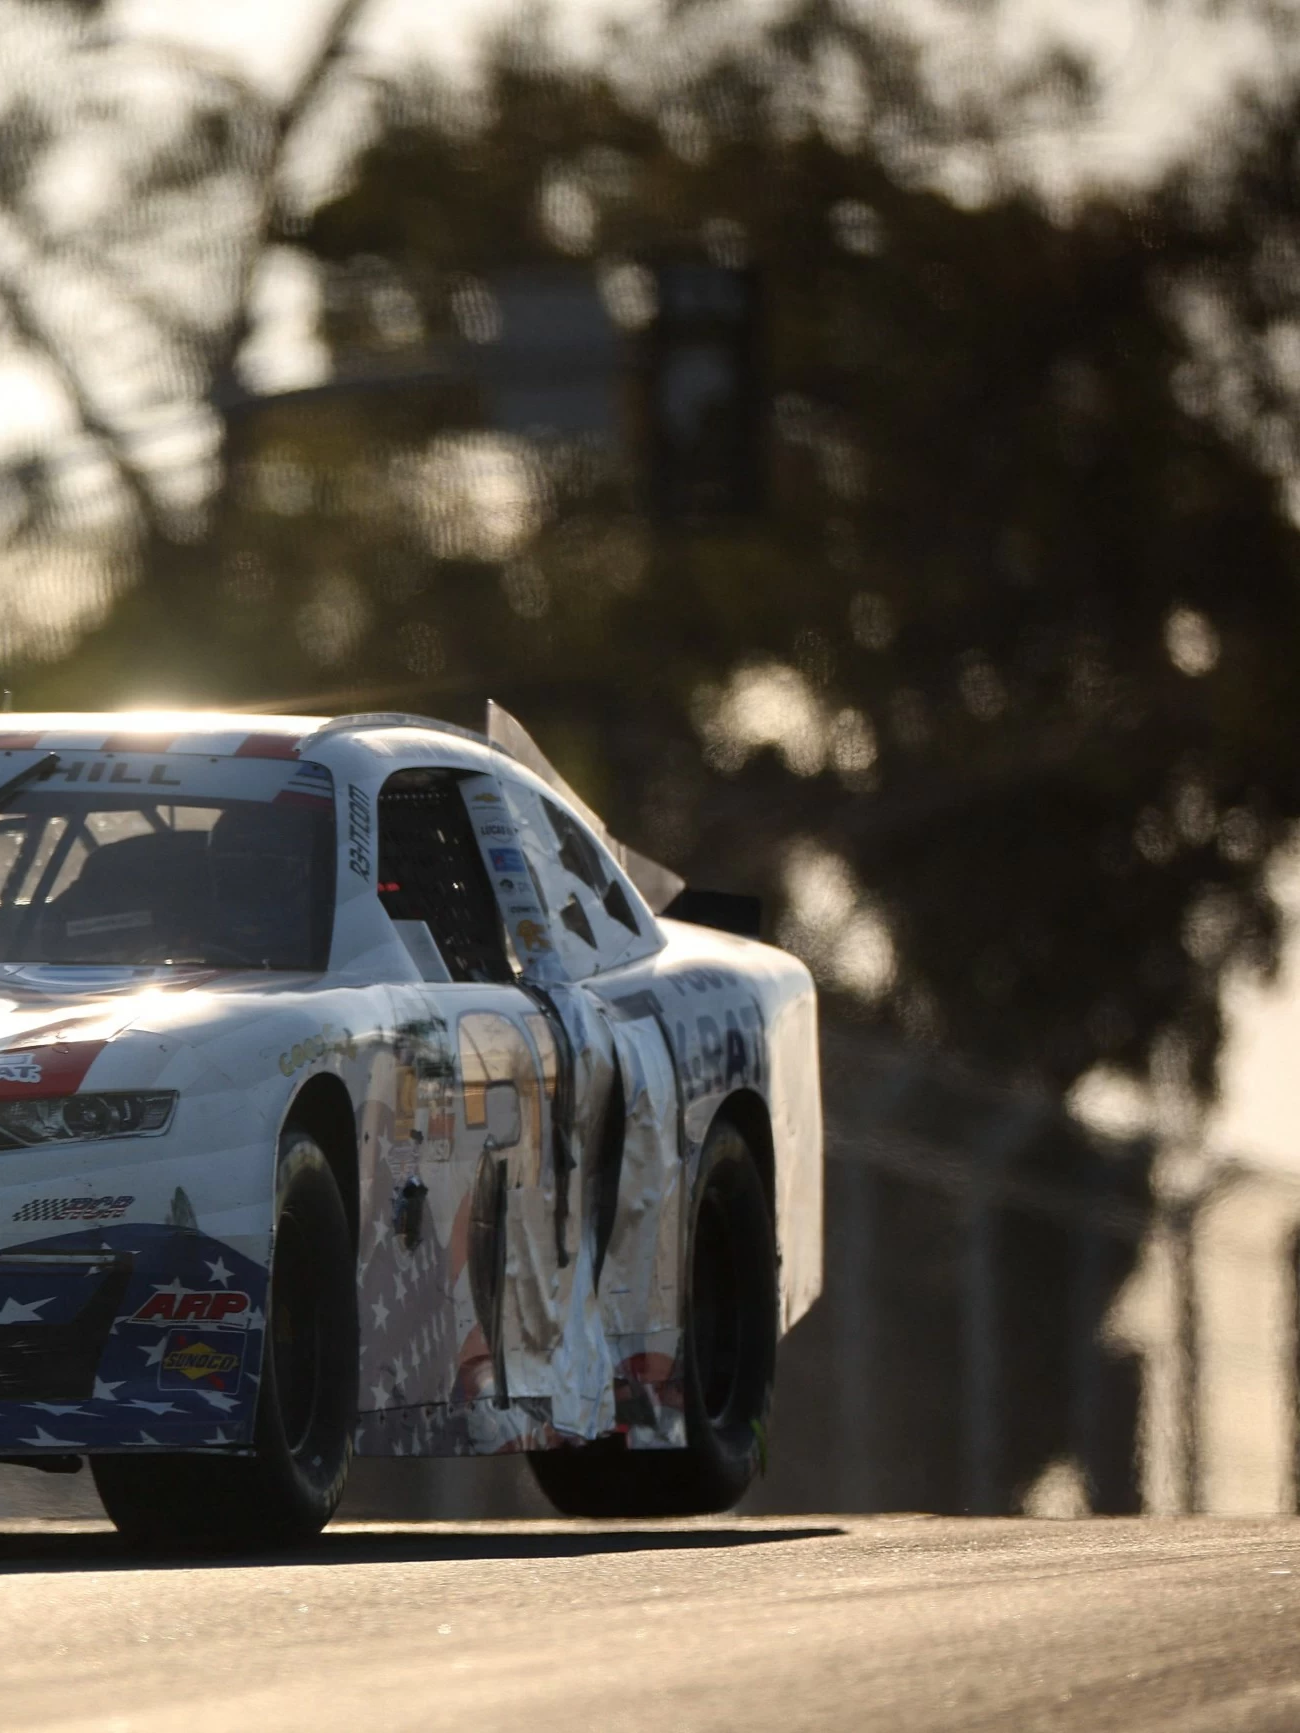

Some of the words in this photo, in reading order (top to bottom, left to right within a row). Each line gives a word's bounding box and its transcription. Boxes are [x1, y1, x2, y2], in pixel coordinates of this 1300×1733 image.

[39, 761, 182, 786] HILL
[134, 1292, 248, 1321] ARP
[169, 1351, 235, 1371] SUNOCO
